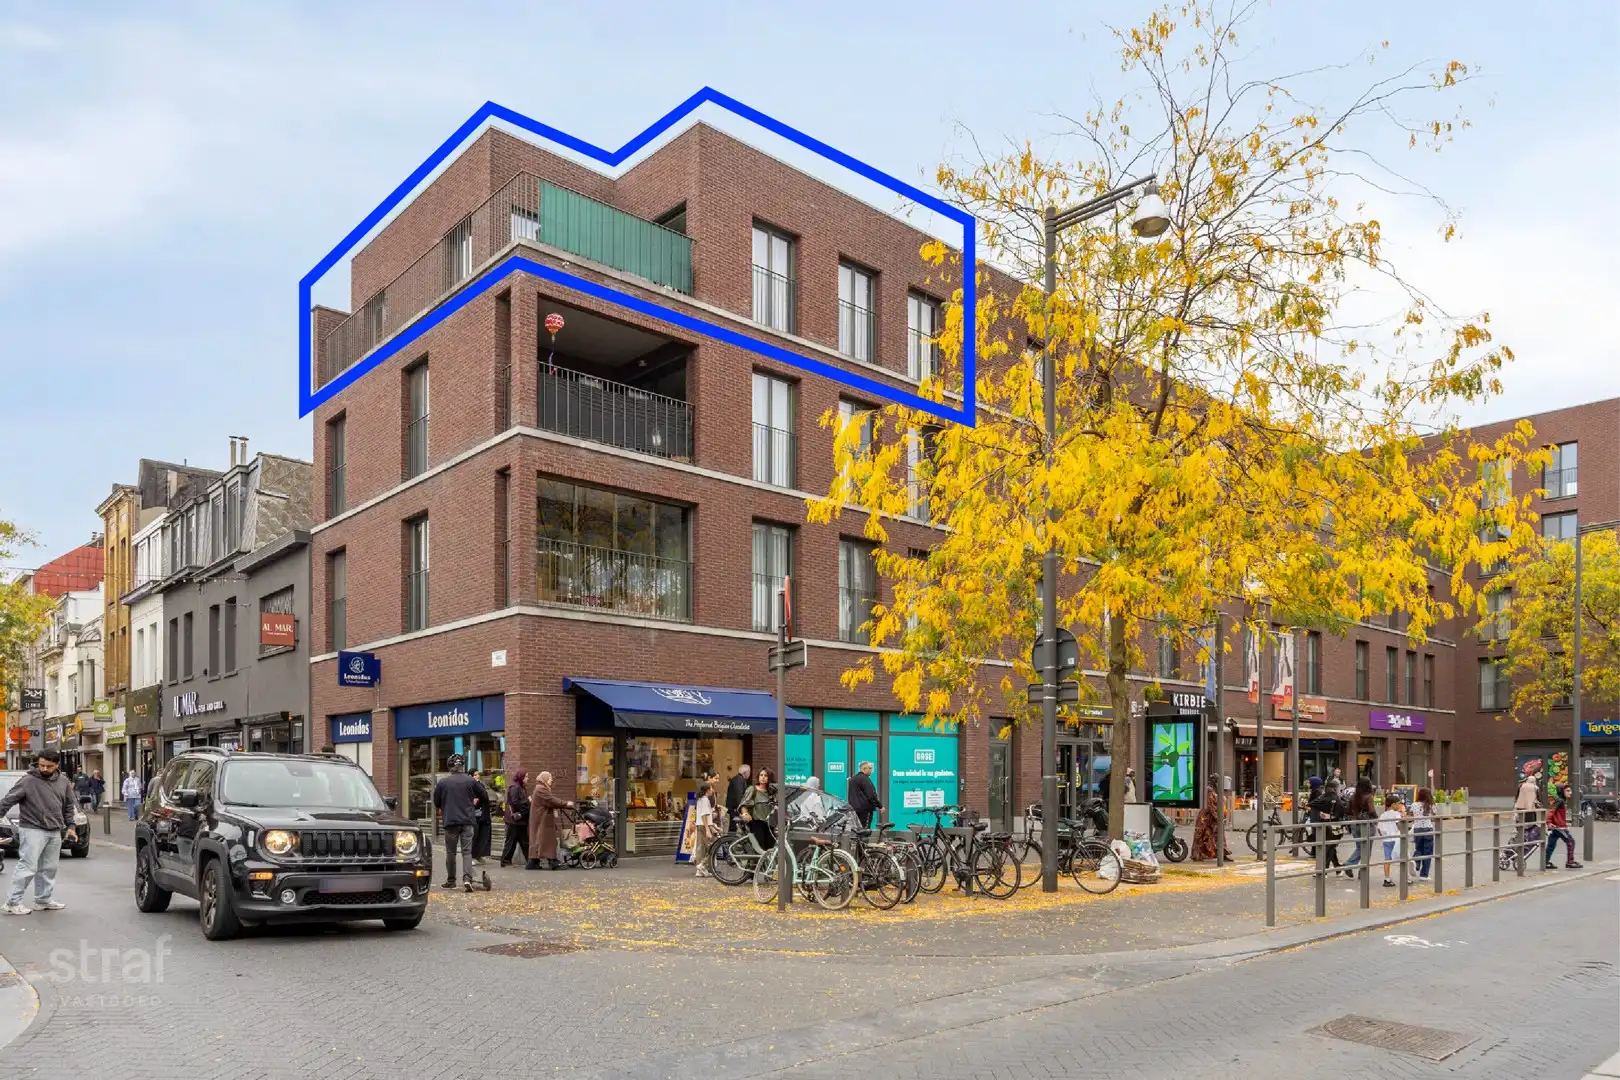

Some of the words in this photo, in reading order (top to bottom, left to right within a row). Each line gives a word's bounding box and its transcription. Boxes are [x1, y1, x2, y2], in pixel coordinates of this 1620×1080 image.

[262, 623, 272, 632] AL
[275, 623, 293, 633] MAR
[173, 695, 181, 718] AL
[182, 691, 198, 716] MAR
[1173, 692, 1206, 708] KIRBIE
[428, 707, 469, 729] Leonidas
[685, 719, 693, 727] The
[694, 719, 713, 730] Preferred
[714, 720, 730, 732] Belgian
[339, 718, 369, 736] Leonidas
[915, 750, 934, 762] BASE
